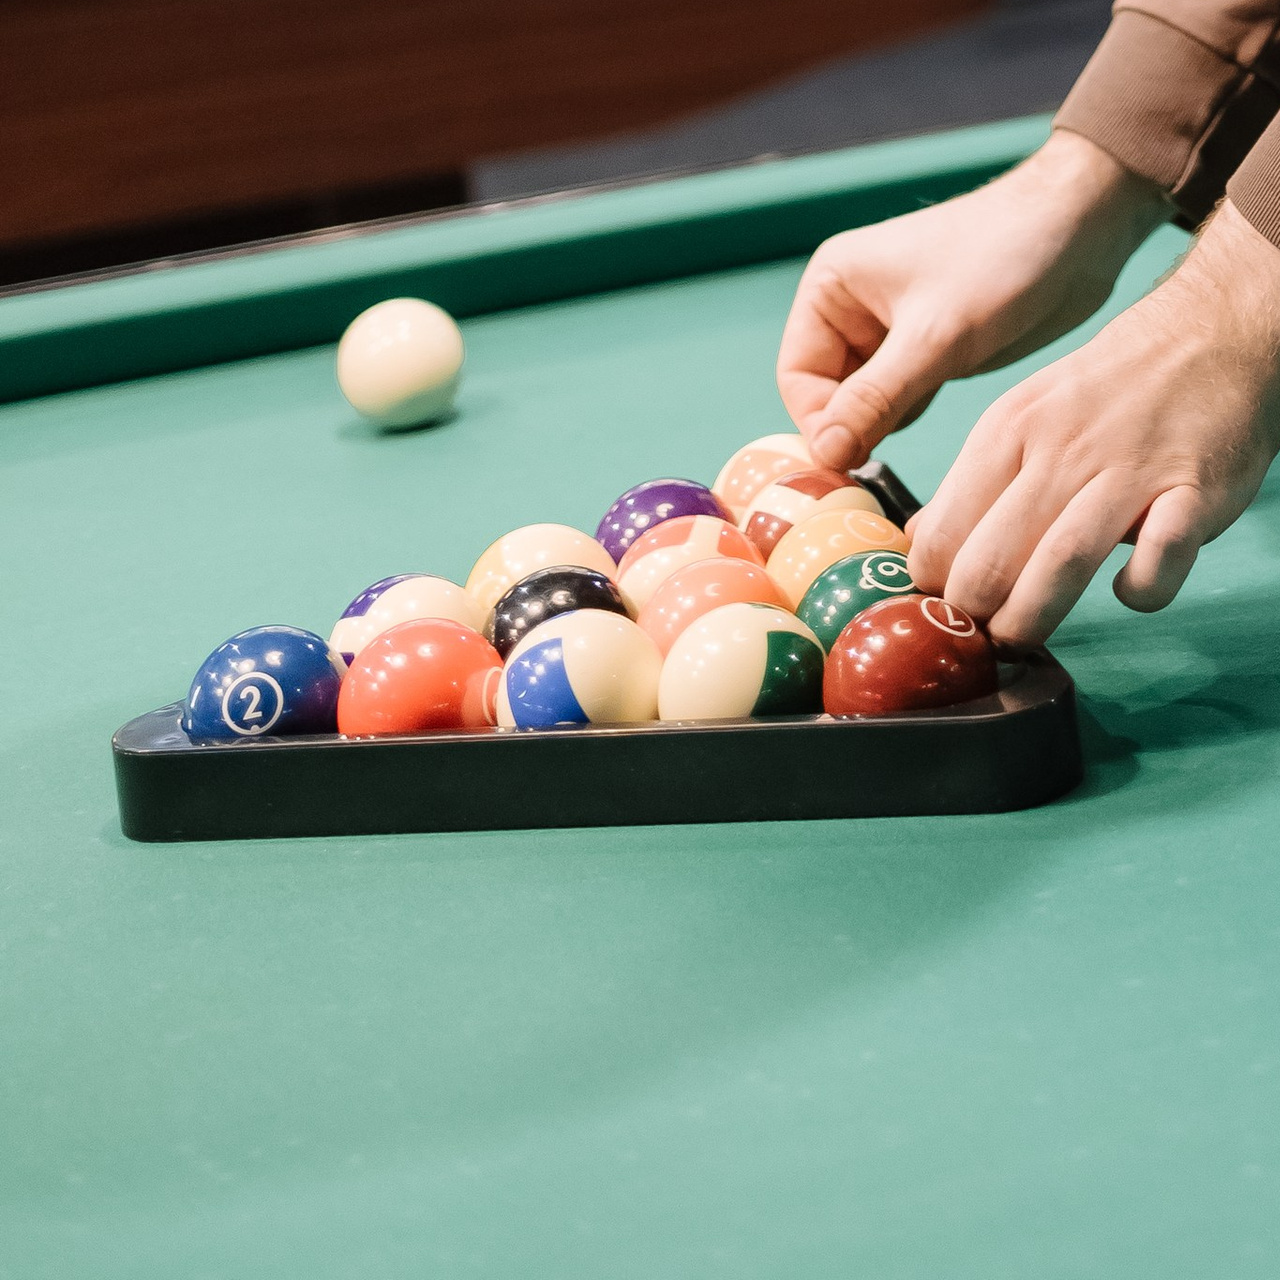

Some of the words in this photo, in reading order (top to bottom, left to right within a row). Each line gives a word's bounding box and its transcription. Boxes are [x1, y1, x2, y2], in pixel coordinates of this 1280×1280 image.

[877, 561, 909, 576] 6
[944, 604, 965, 626] 7
[240, 685, 263, 721] 2
